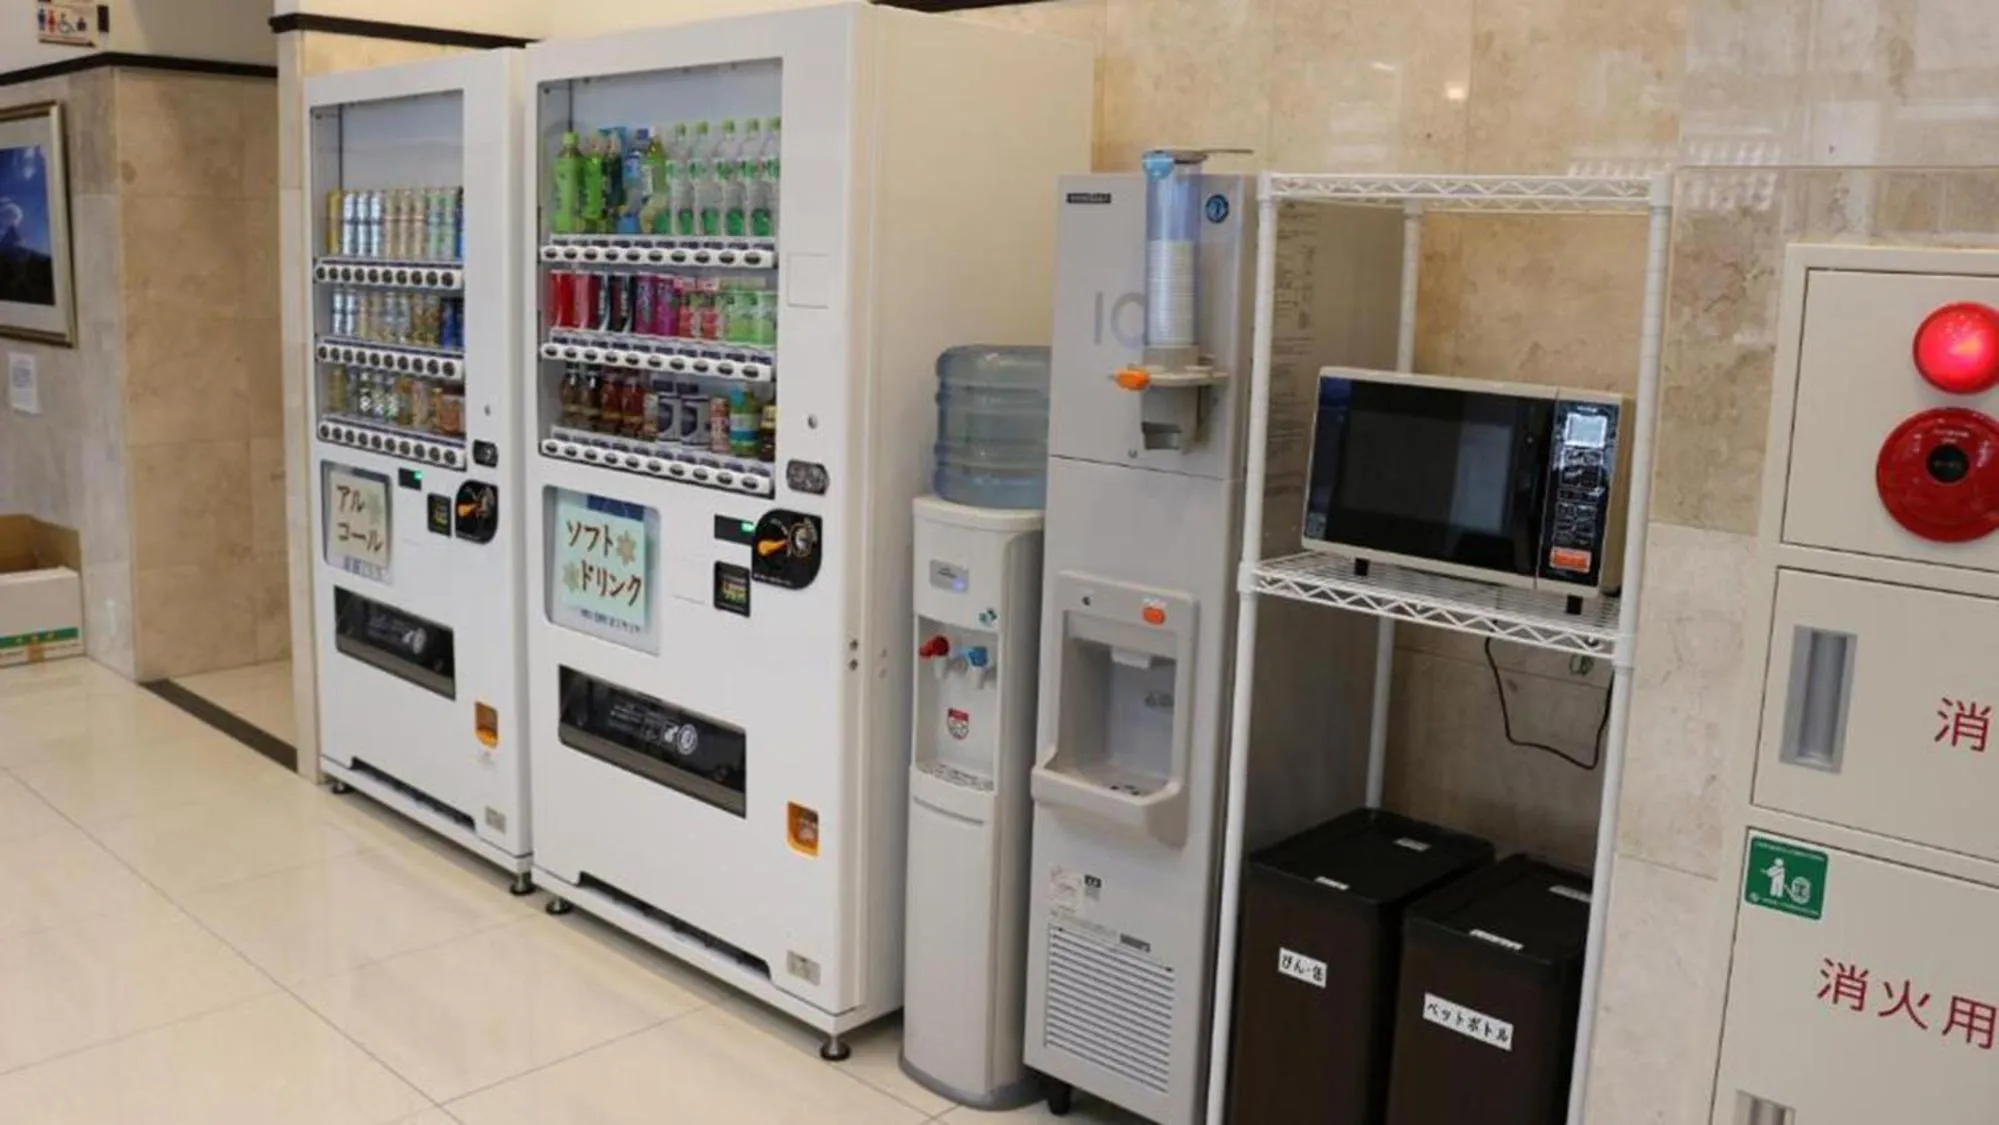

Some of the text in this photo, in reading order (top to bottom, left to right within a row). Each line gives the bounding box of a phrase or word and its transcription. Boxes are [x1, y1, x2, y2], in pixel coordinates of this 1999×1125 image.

[336, 483, 365, 512] アル
[337, 521, 383, 552] コール
[566, 518, 614, 556] ソフト
[581, 560, 642, 607] ドリンク
[1934, 697, 1992, 752] 消
[1427, 1003, 1509, 1043] ペットボトル
[1816, 957, 1997, 1051] 消火用
